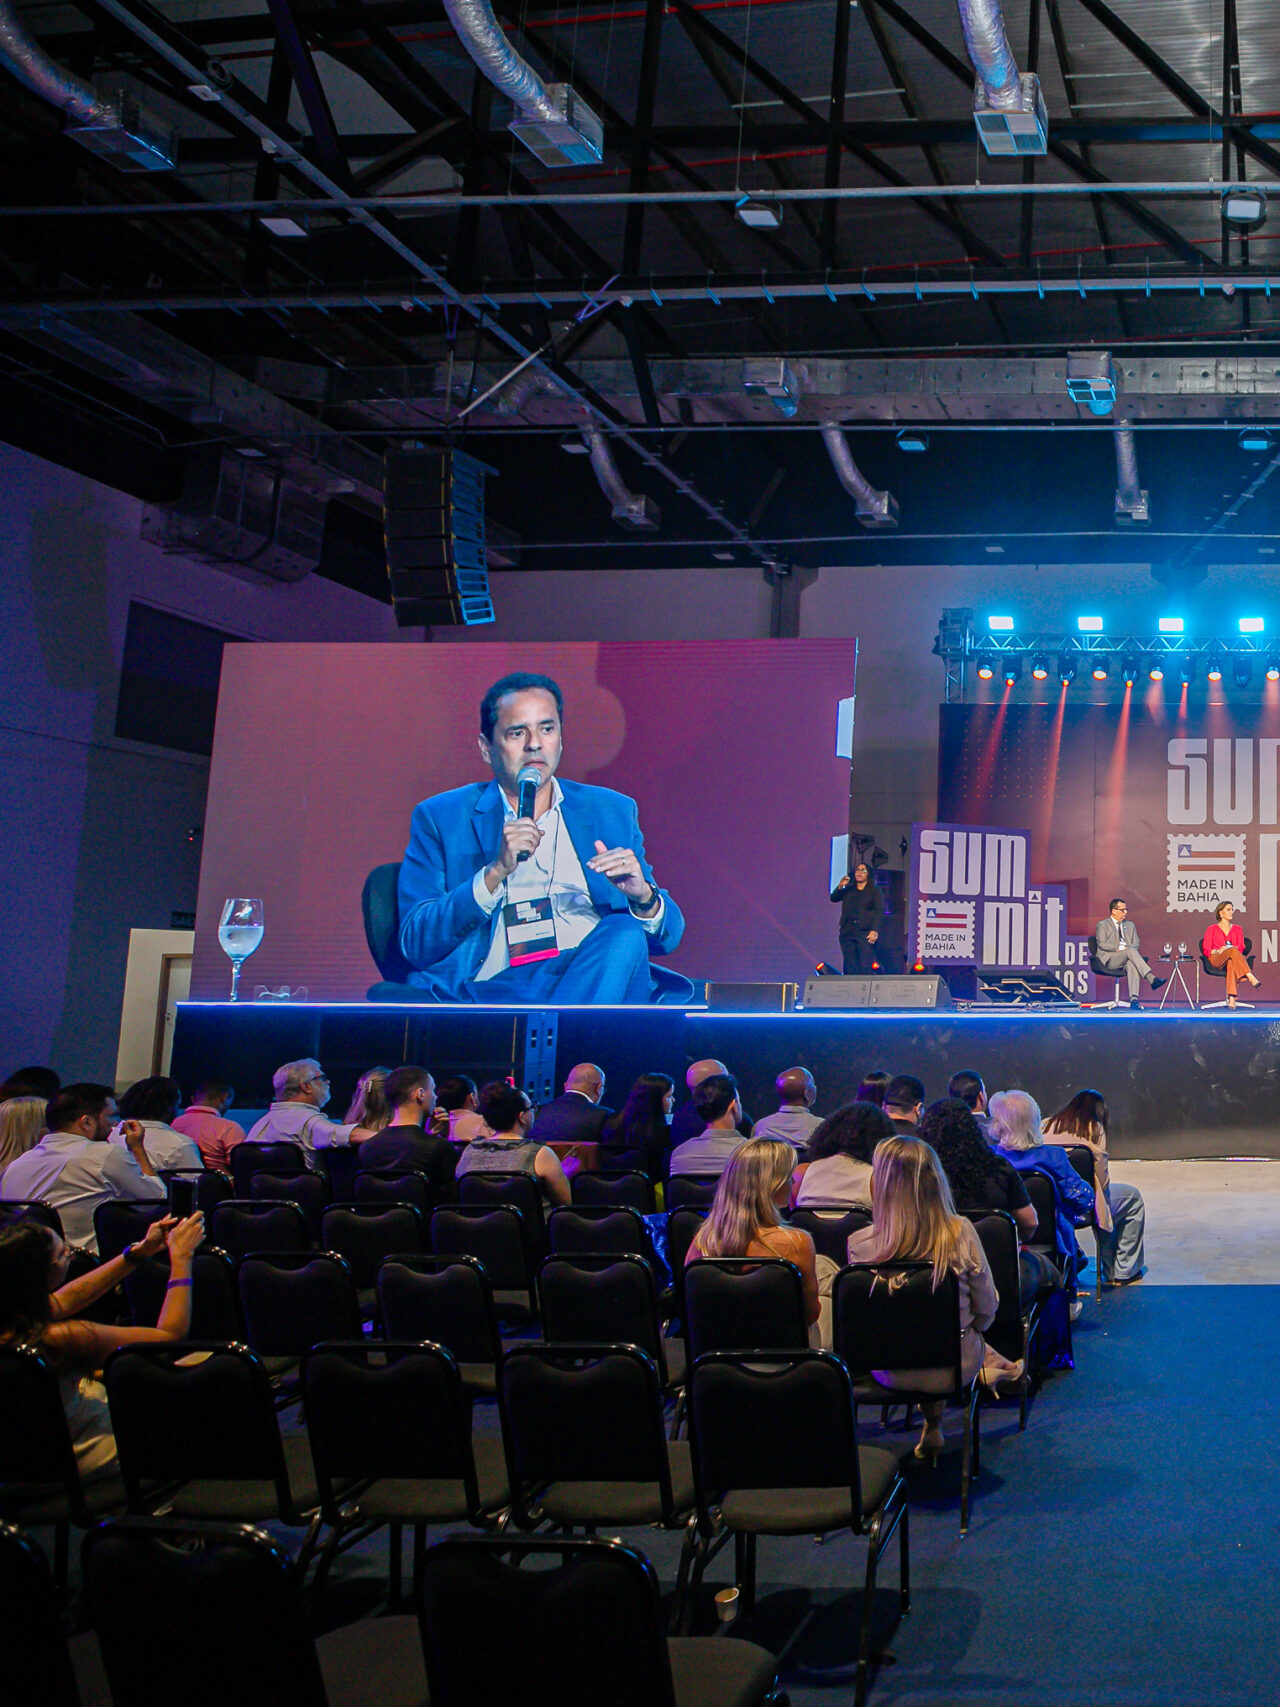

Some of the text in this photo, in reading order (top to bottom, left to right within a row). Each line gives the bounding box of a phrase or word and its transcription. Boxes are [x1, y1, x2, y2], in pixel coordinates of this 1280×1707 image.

[1177, 879, 1234, 890] MADE IN
[1177, 892, 1220, 902] BAHIA
[925, 933, 966, 942] MADE IN
[924, 942, 956, 951] BAHIA
[1064, 941, 1089, 966] DE
